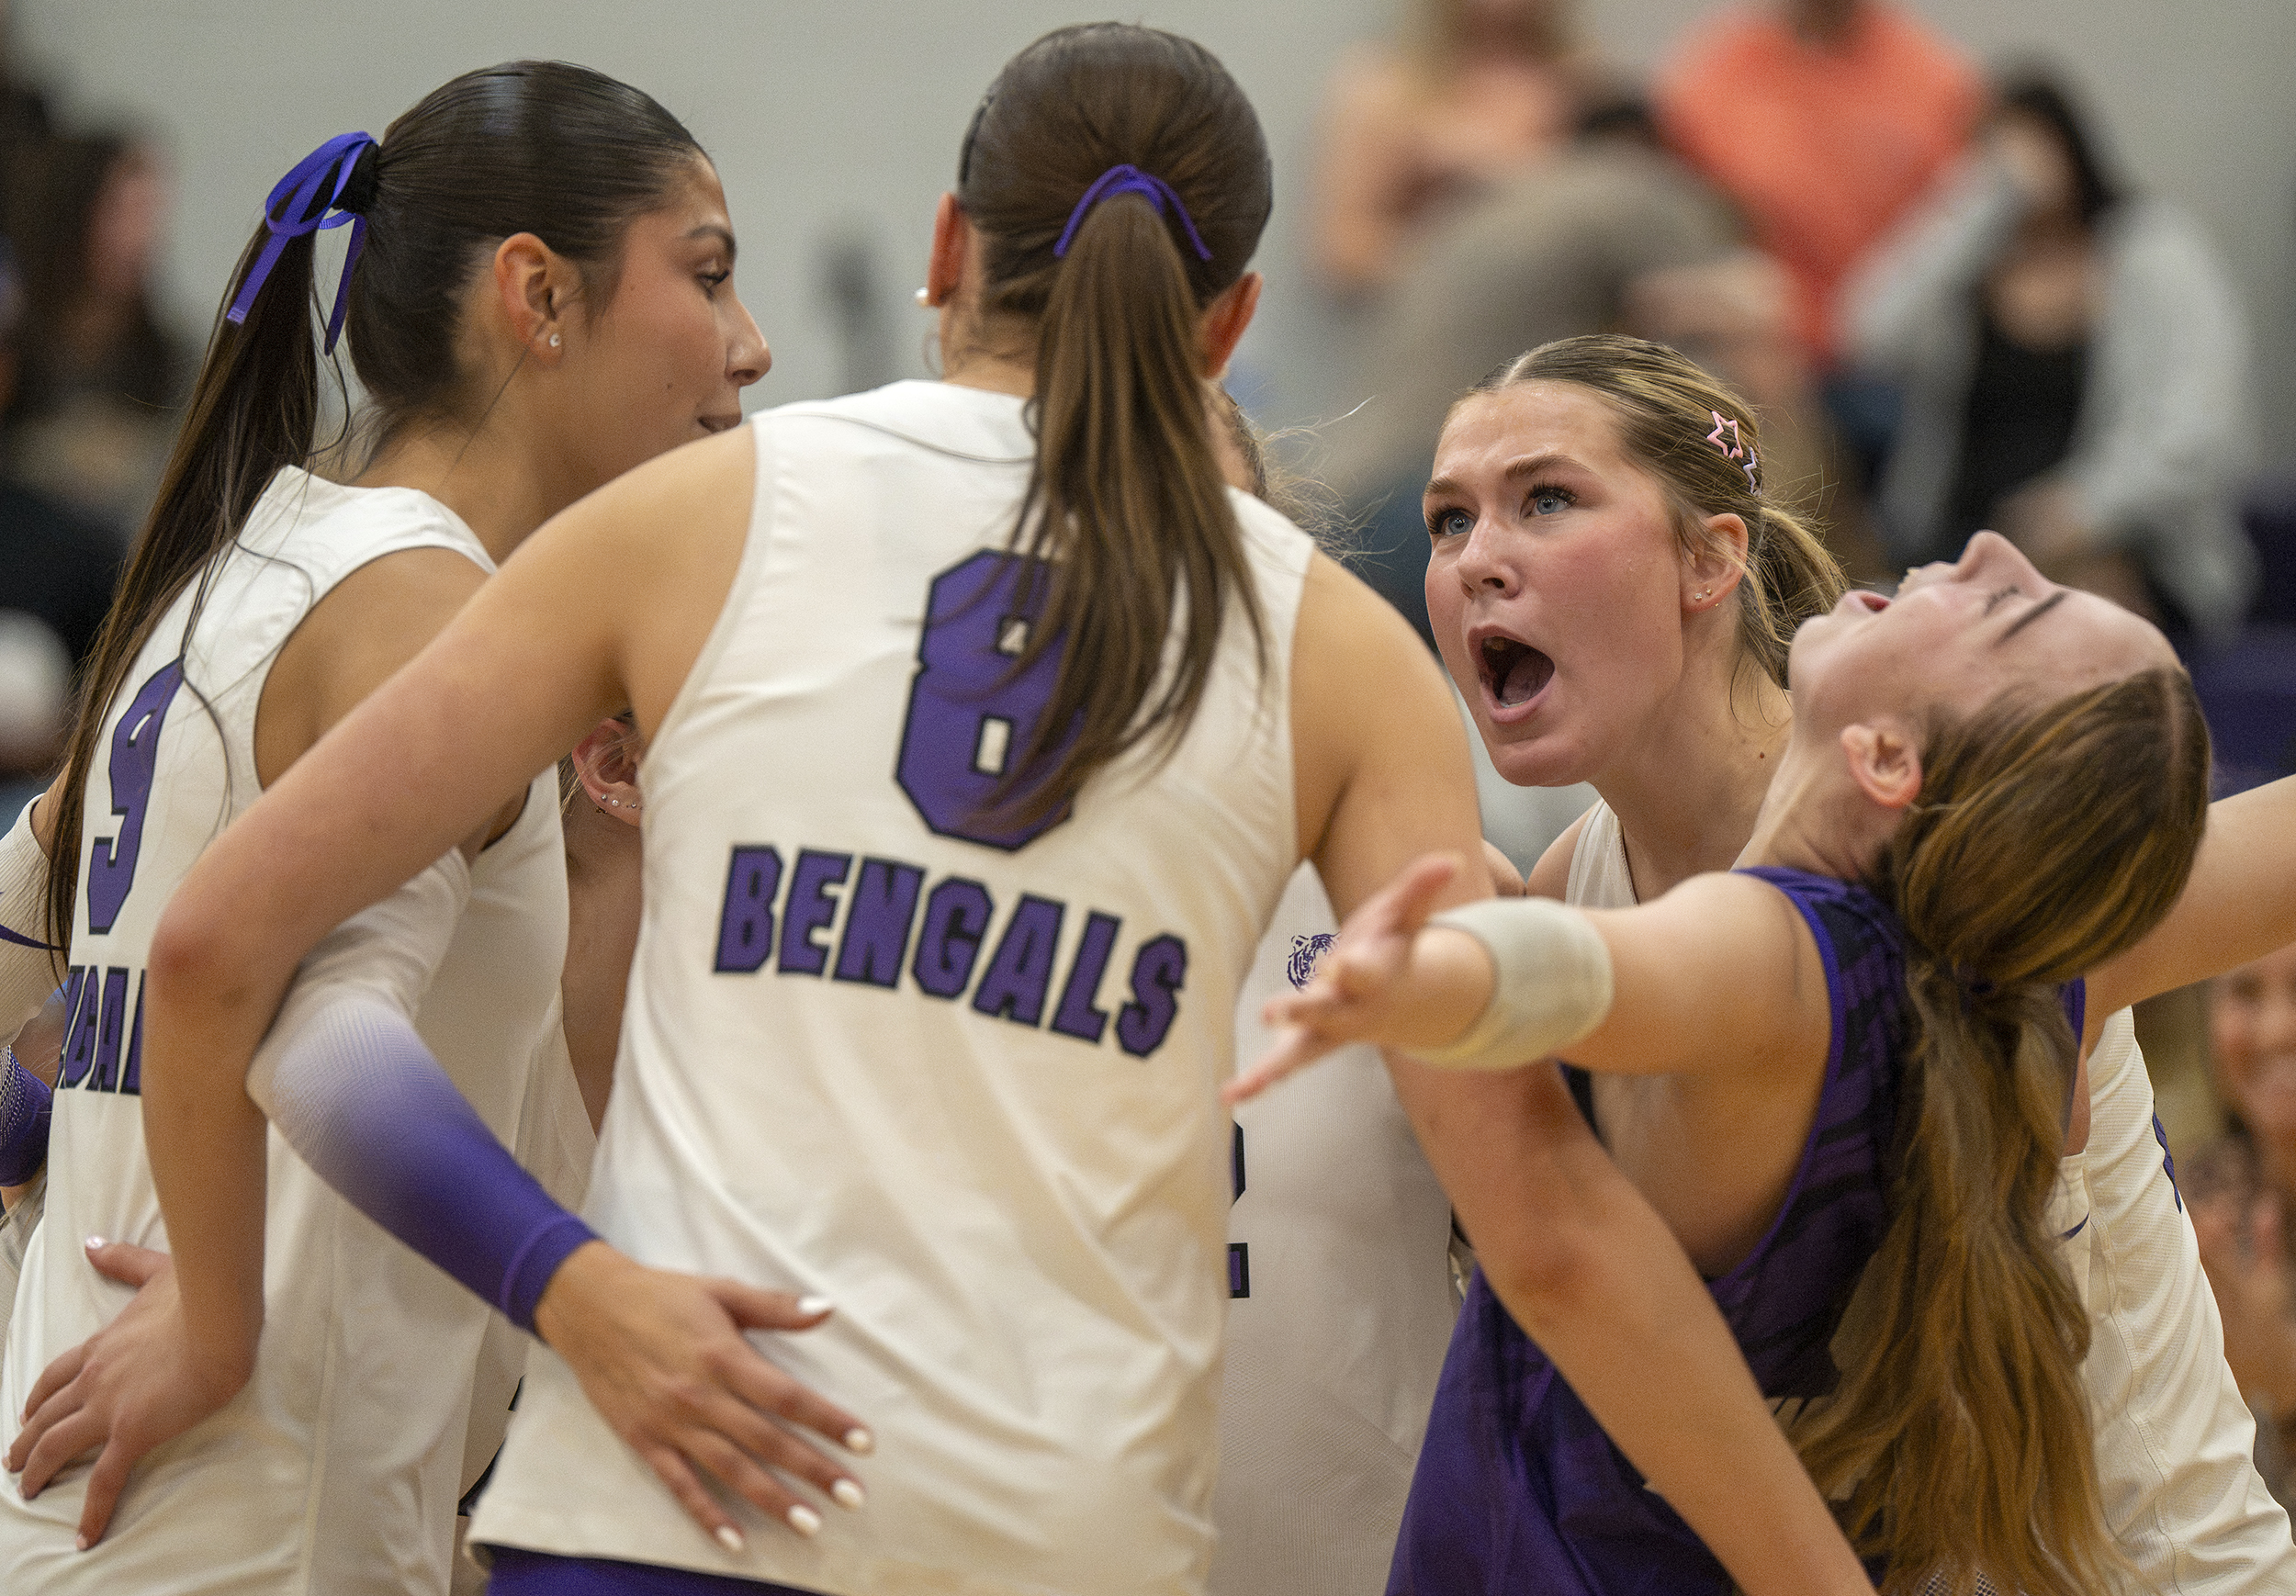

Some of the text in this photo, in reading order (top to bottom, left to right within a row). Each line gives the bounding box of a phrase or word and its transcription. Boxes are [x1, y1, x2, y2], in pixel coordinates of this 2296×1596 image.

[87, 656, 184, 935] 9
[895, 546, 1091, 854] 8
[712, 843, 1188, 1062] BENGALS
